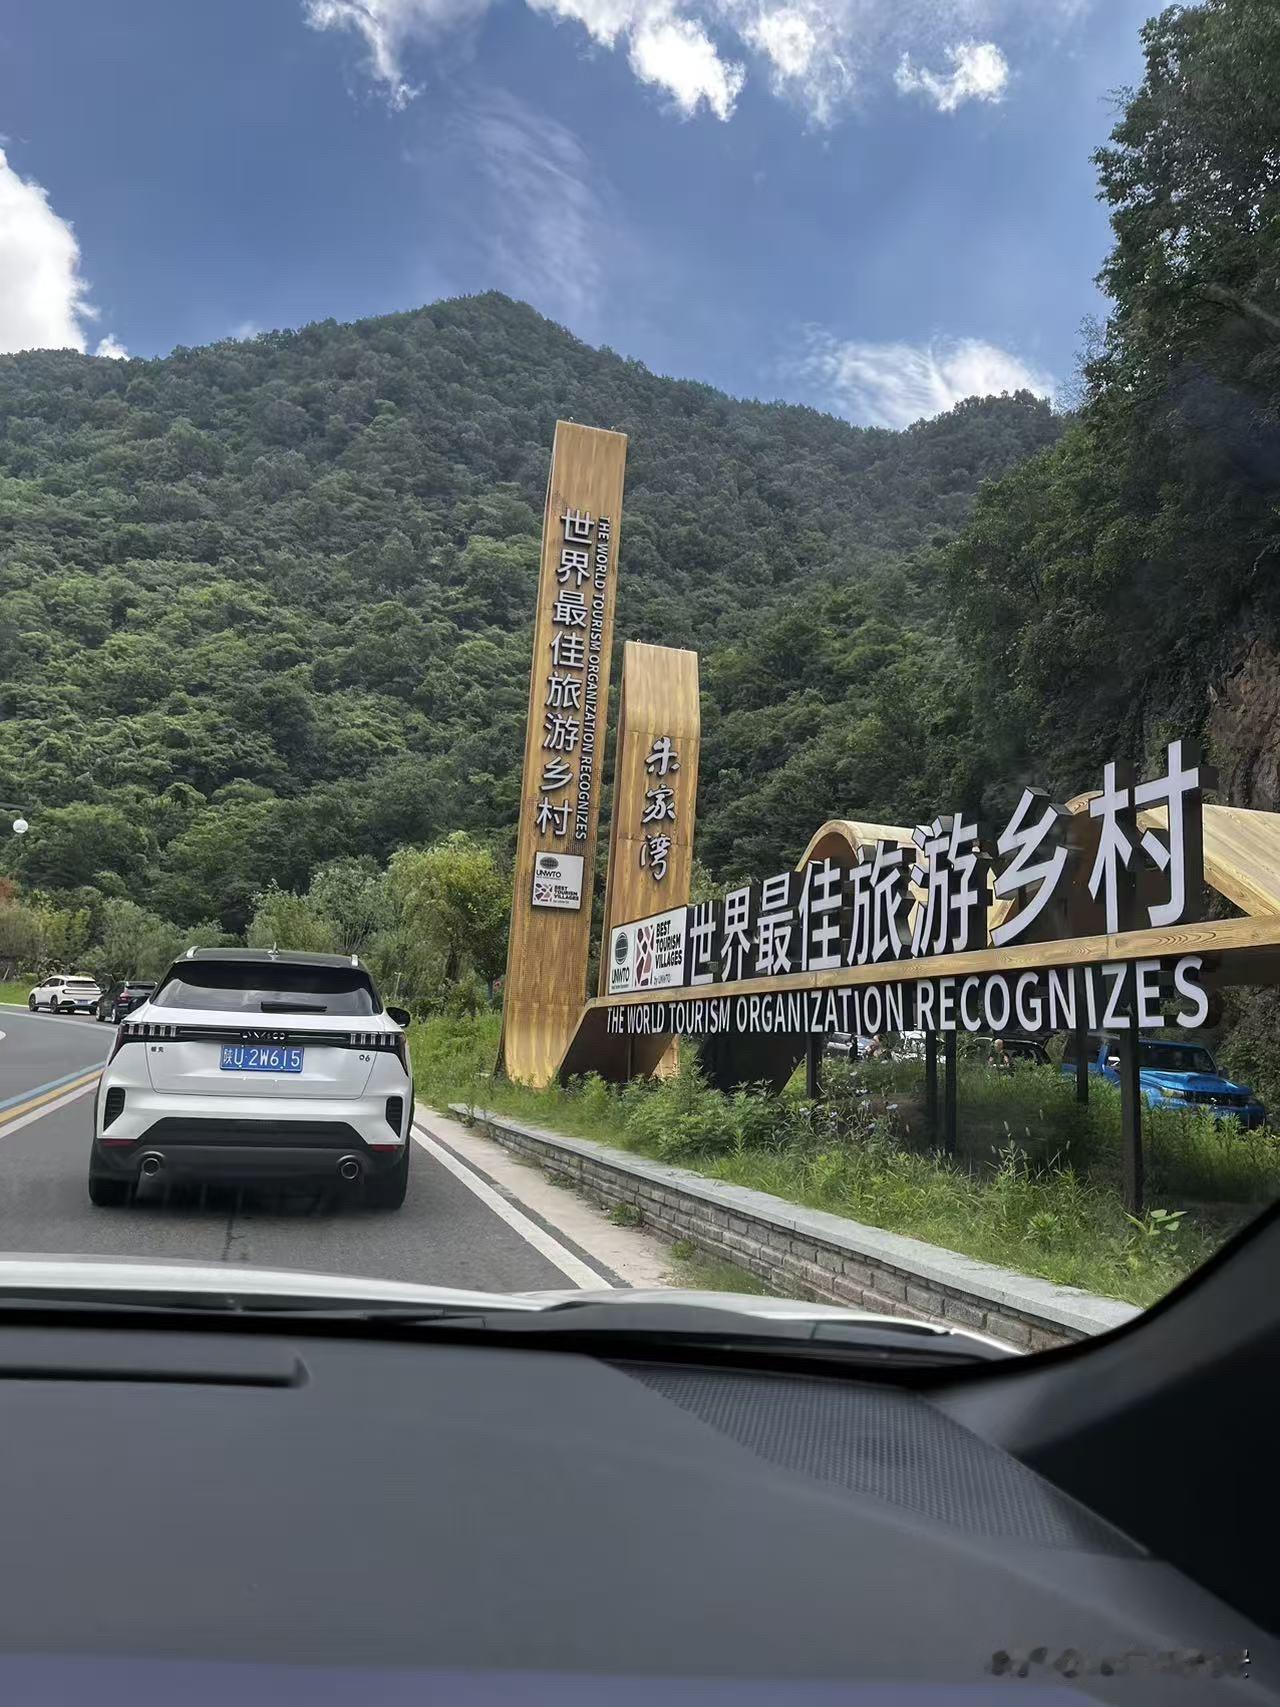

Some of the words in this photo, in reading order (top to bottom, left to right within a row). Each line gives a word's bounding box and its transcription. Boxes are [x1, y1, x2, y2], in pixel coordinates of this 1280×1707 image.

[598, 515, 611, 540] THE
[594, 543, 609, 589] WORLD
[589, 593, 605, 651] TOURISM
[535, 508, 595, 836] 世界最佳旅游乡村
[582, 655, 600, 752] ORGANIZATION
[575, 756, 593, 840] RECOGNIZES
[639, 736, 681, 881] 朱家湾
[536, 869, 562, 878] UNWTO
[689, 739, 1201, 985] 世界最佳旅游乡村
[656, 920, 671, 938] BEST
[656, 933, 681, 953] TOURISM
[612, 967, 630, 984] UNWTO
[655, 950, 683, 969] VILLAGES
[607, 1006, 625, 1033] THE
[627, 1002, 665, 1034] WORLD
[669, 997, 731, 1034] TOURISM
[736, 982, 904, 1034] ORGANIZATION
[916, 955, 1209, 1032] RECOGNIZES
